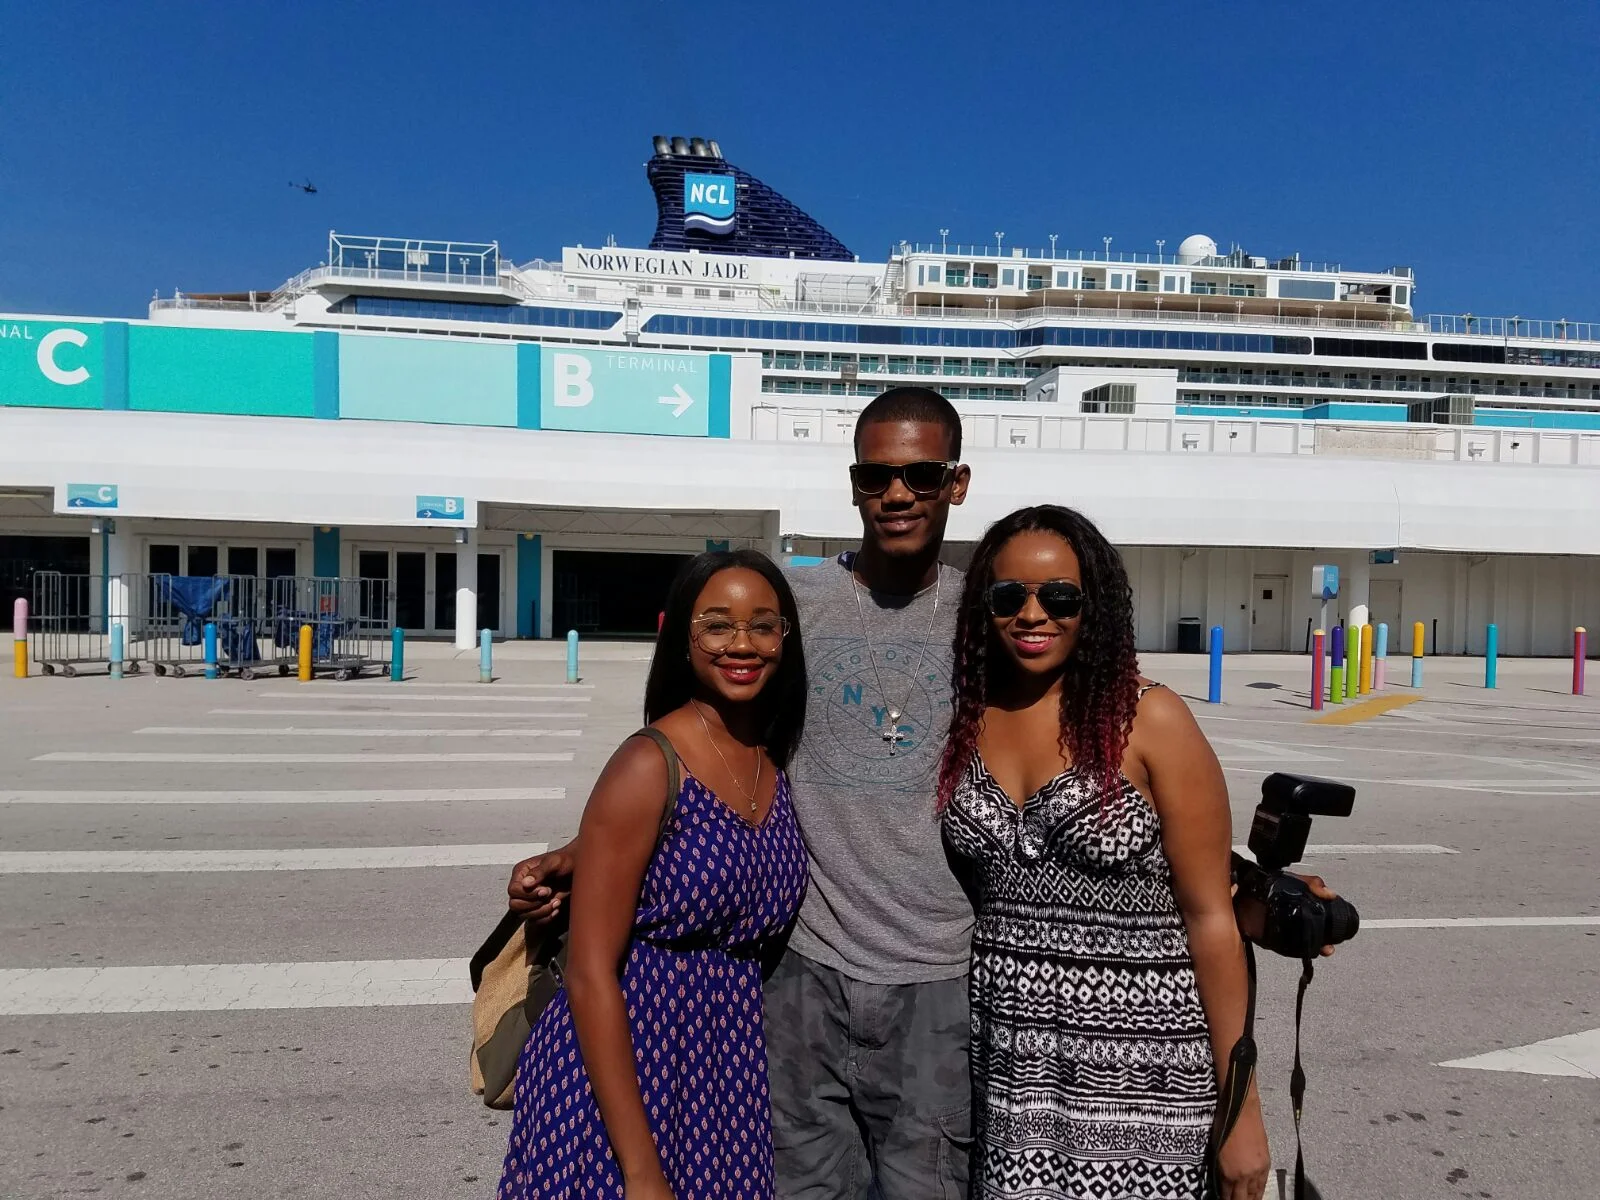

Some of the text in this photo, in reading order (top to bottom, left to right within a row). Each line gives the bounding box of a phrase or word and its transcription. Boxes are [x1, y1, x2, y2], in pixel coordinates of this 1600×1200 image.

[690, 183, 730, 205] NCL
[577, 252, 749, 279] NORWEGIAN JADE
[37, 328, 90, 386] C
[553, 353, 698, 407] B TERMINAL
[98, 486, 113, 502] C
[445, 498, 457, 513] B
